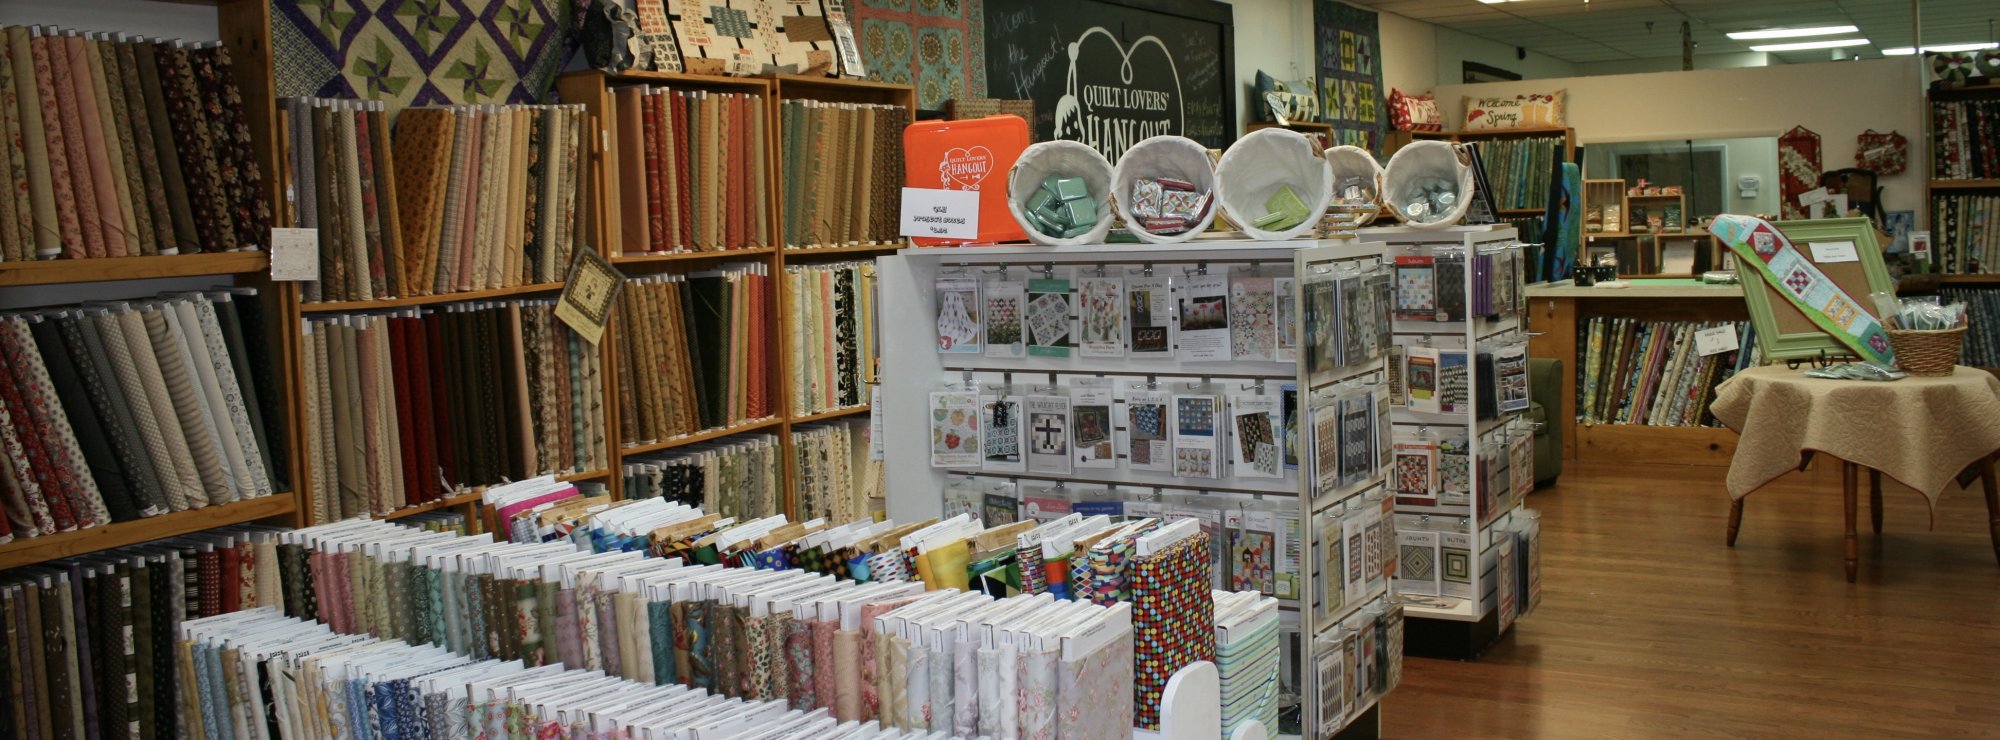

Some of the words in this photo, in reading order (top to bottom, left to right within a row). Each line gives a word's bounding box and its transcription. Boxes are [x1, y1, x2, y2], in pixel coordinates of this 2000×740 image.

[1083, 84, 1121, 112] QUILT
[1123, 88, 1169, 111] LOVERS'
[1486, 110, 1517, 134] Spring
[951, 161, 987, 176] HANGOUT
